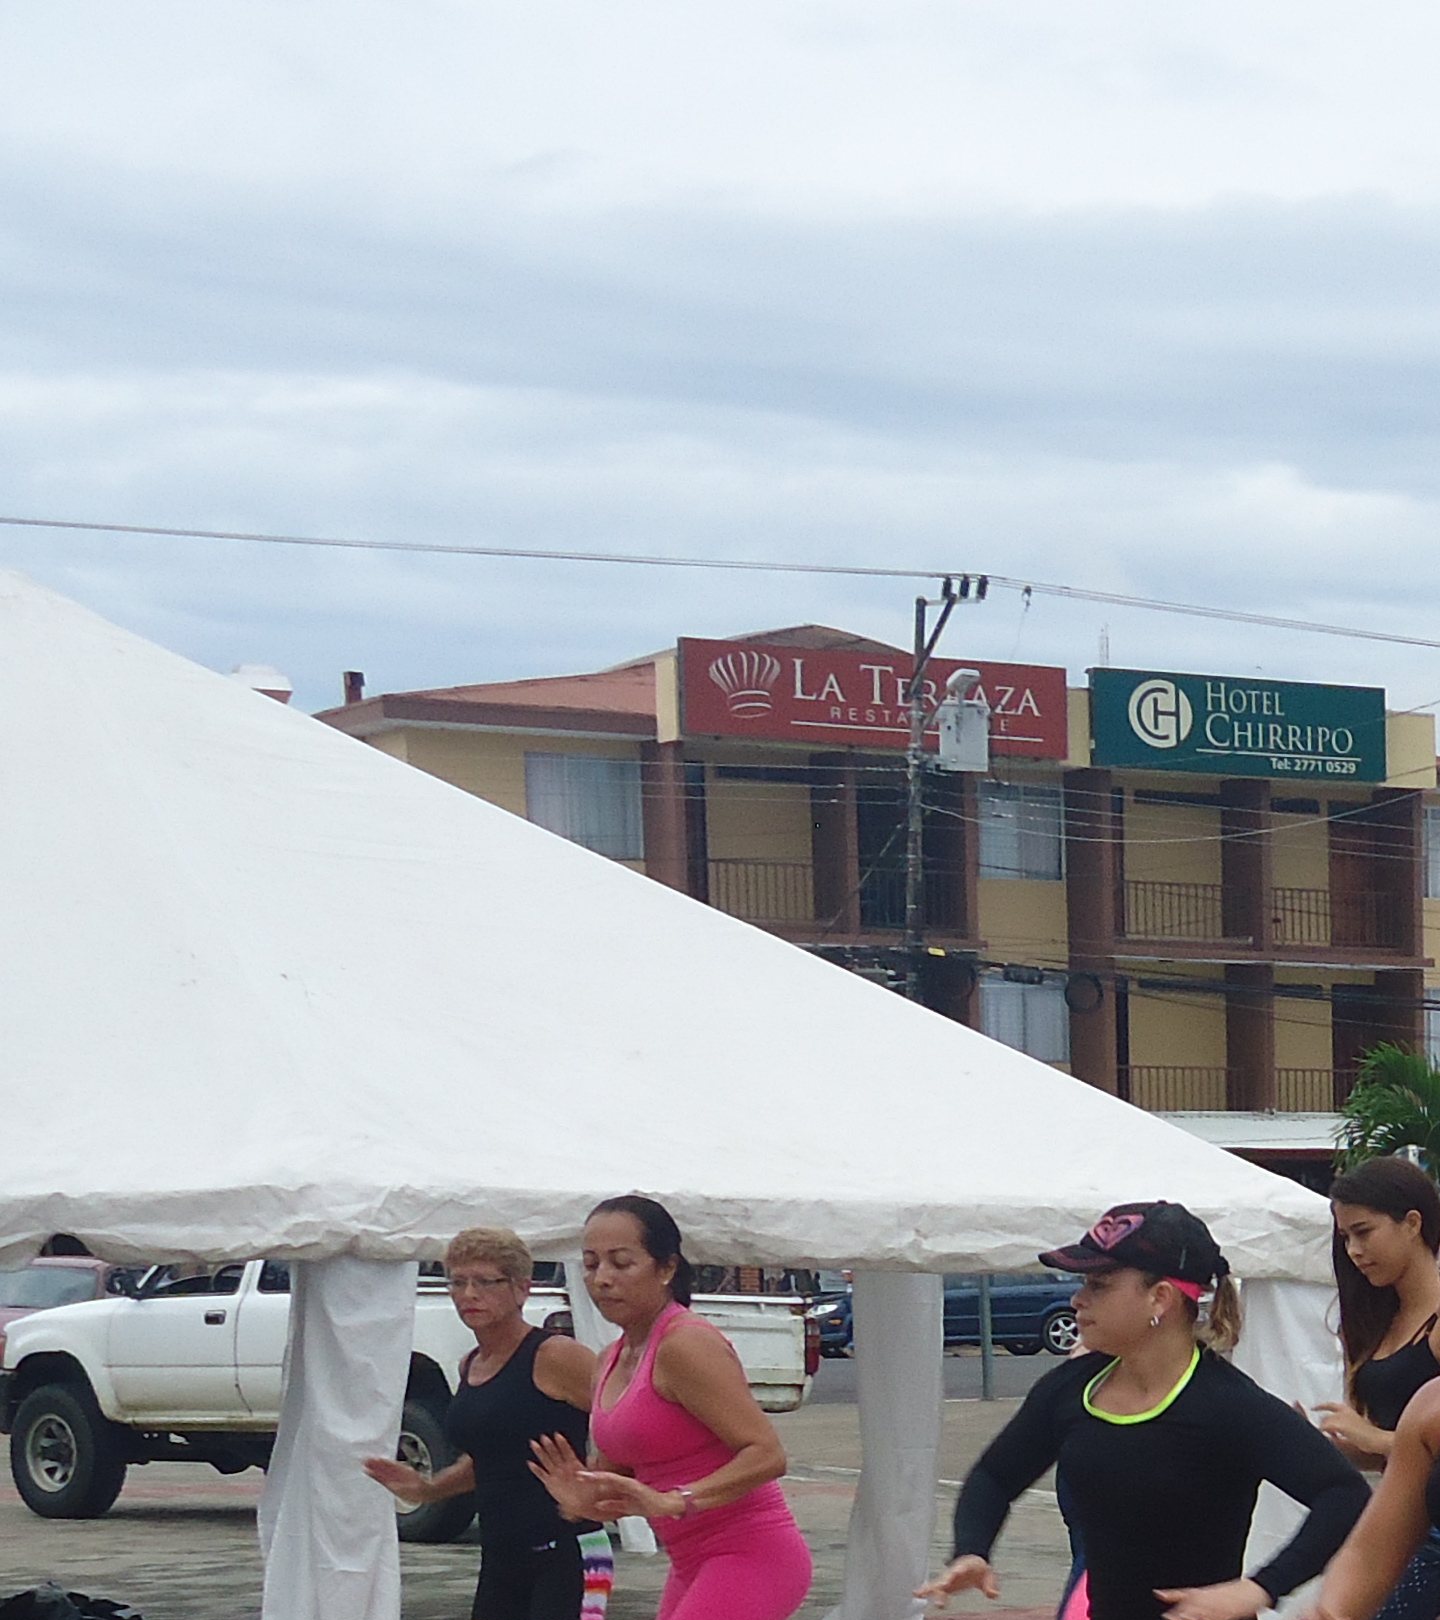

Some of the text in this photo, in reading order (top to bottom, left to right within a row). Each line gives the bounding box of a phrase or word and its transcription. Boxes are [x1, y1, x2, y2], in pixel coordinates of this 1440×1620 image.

[792, 658, 1042, 718] LA TERAZA
[1205, 681, 1286, 717] HOTEL
[1205, 713, 1354, 754] CHIRRIPO
[1270, 757, 1357, 774] Tel: 2771 0529
